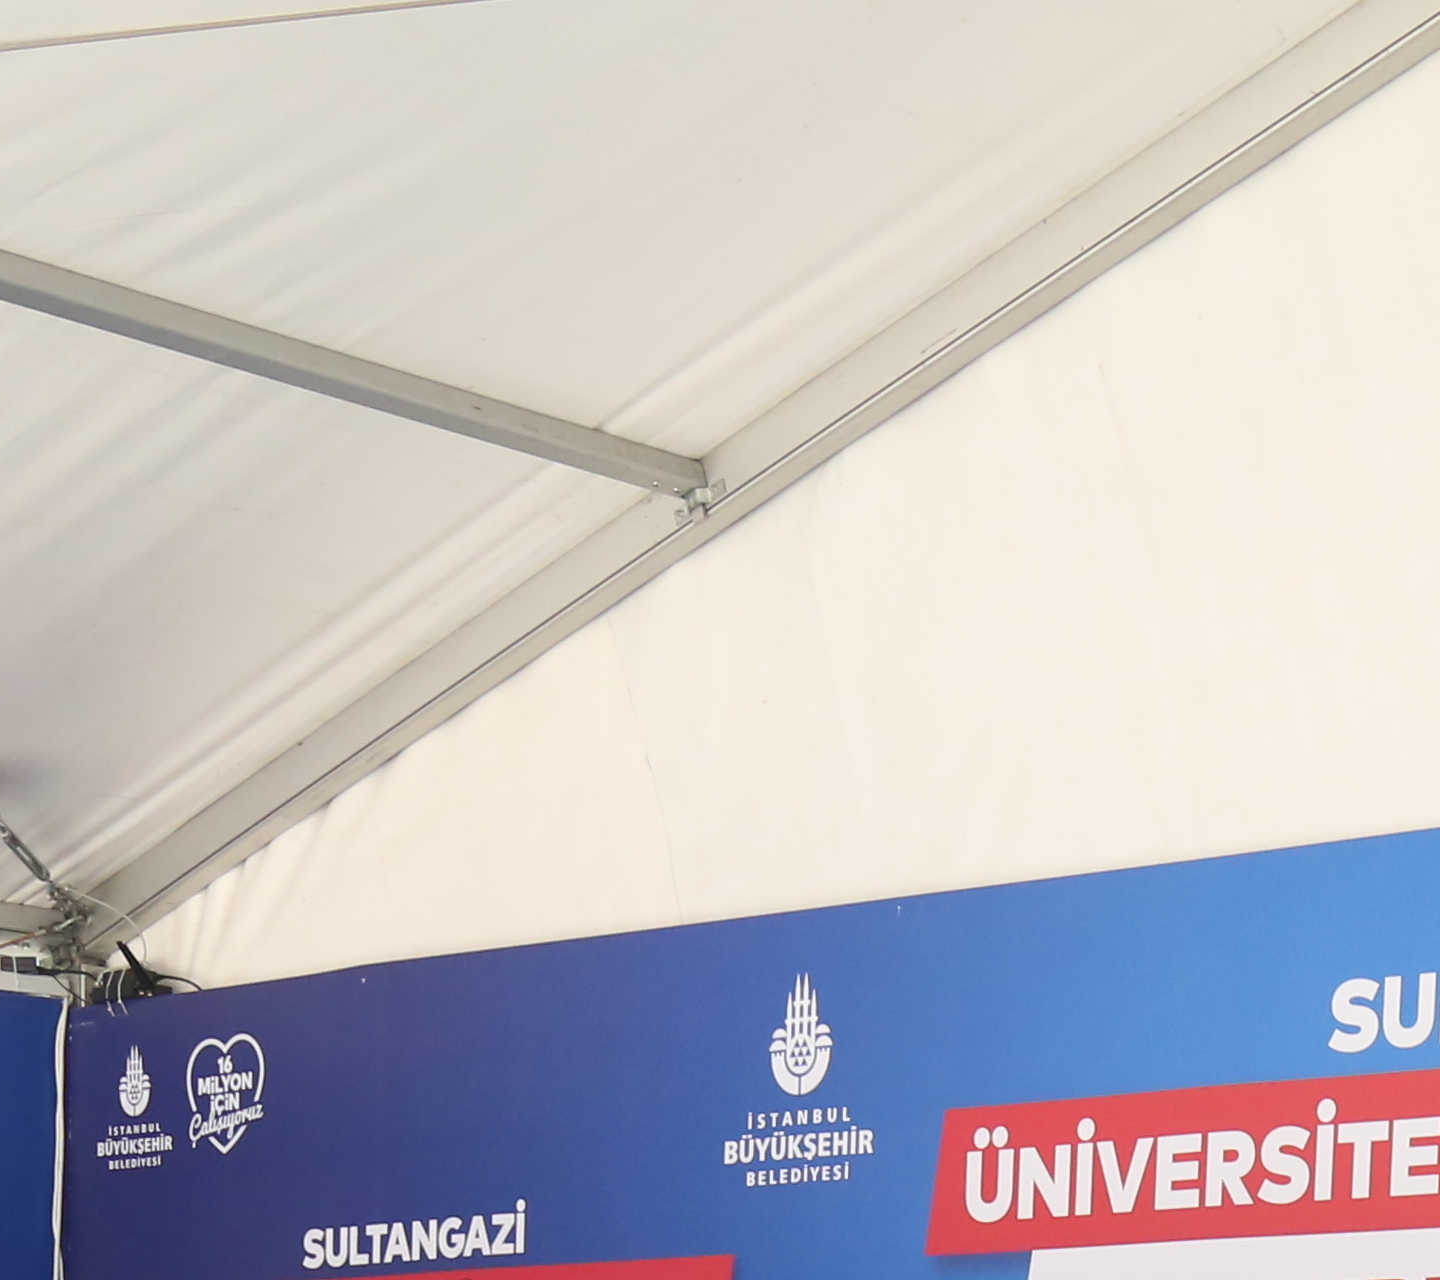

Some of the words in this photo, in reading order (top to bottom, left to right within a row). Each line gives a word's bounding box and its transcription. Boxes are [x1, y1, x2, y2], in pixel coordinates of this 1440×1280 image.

[217, 1055, 233, 1074] 16
[108, 1122, 162, 1137] İSTANBUL
[747, 1106, 851, 1131] İSTANBUL
[96, 1133, 173, 1157] BÜYÜKŞEHİR
[723, 1125, 874, 1166] BÜYÜKŞEHİR
[746, 1161, 850, 1187] BELEDİYESİ
[302, 1198, 527, 1270] SULTANGAZİ
